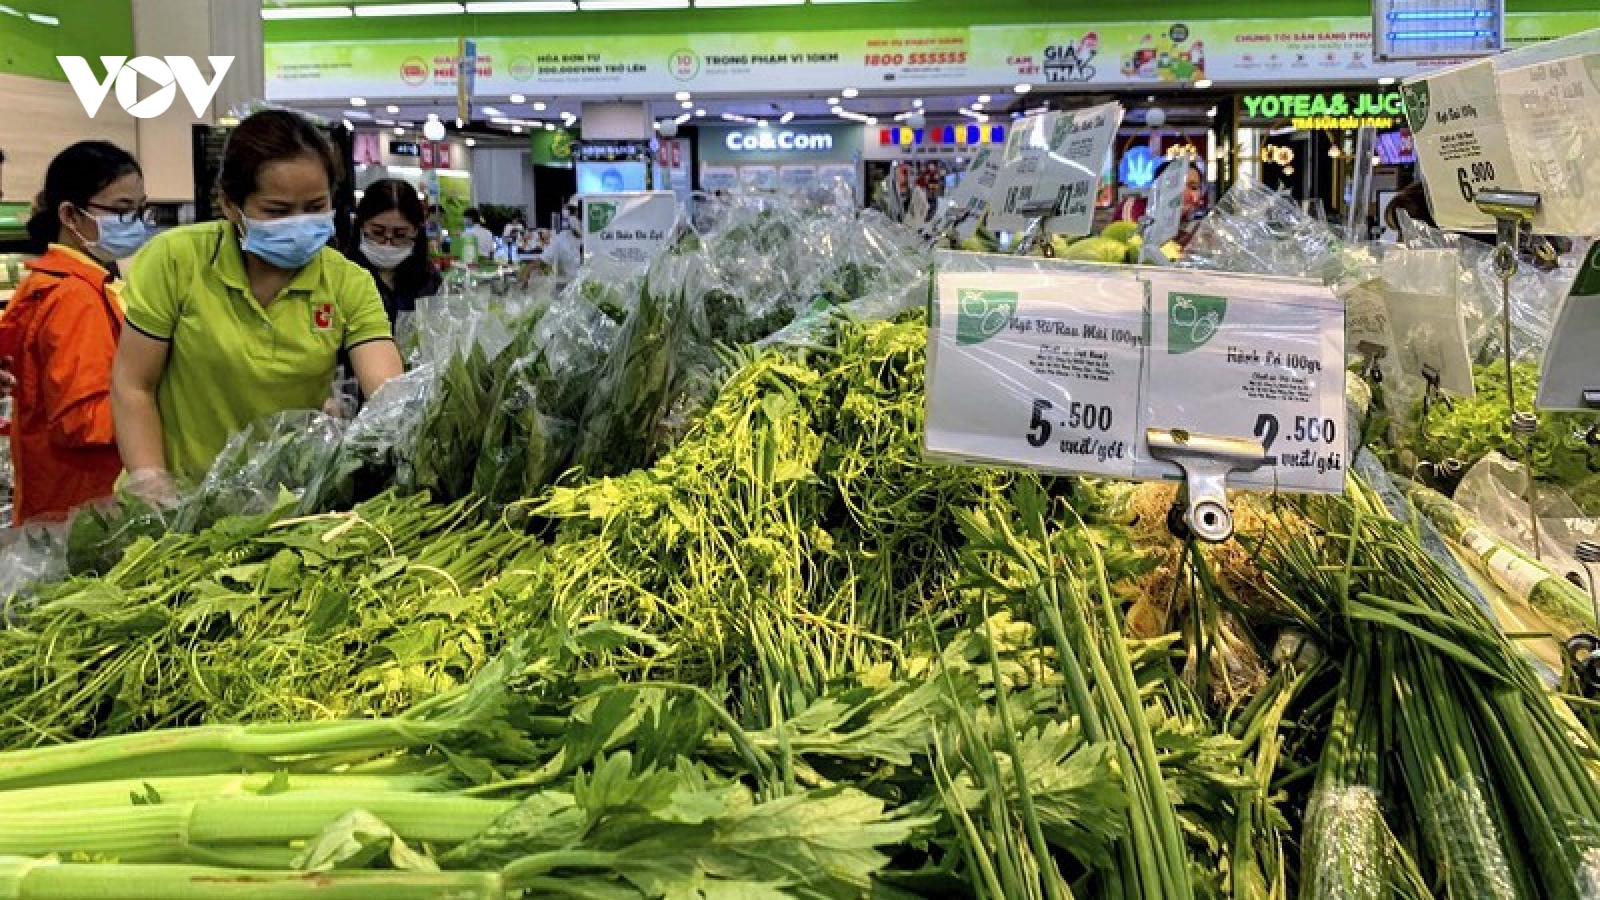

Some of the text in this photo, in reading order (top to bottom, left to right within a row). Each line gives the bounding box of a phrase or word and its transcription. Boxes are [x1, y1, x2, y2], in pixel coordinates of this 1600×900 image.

[705, 55, 749, 66] TRONG
[790, 53, 804, 64] VI
[806, 53, 839, 64] 10KM
[865, 51, 967, 67] 1800 555555
[1244, 92, 1406, 118] YOTEA& JUC
[726, 131, 833, 151] Co&Com
